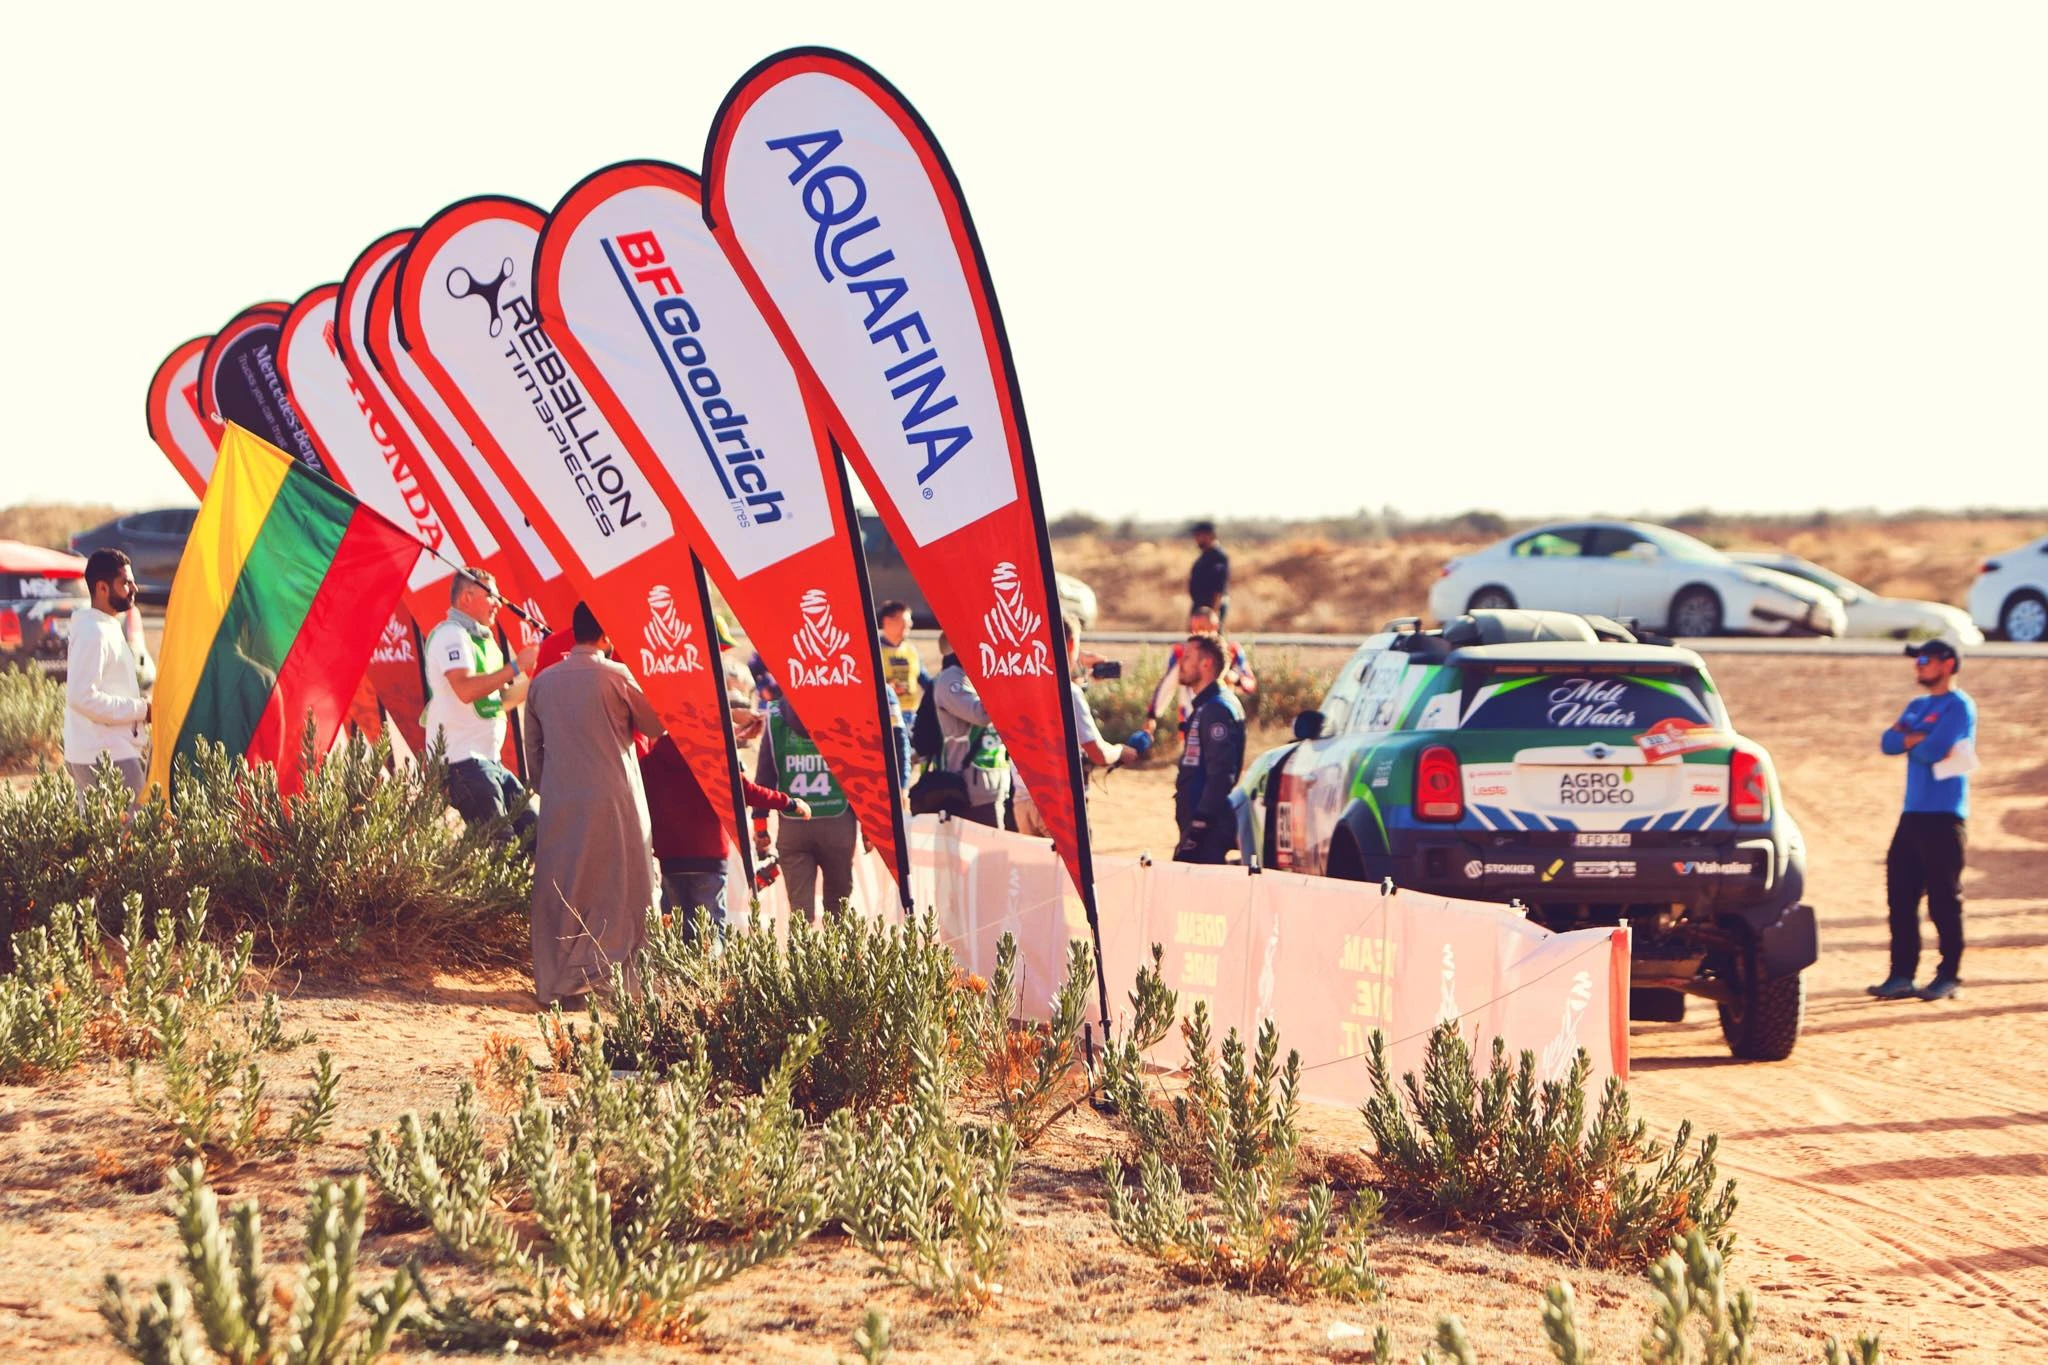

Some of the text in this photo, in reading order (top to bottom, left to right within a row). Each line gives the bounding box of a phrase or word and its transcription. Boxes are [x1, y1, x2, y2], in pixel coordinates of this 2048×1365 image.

[765, 129, 973, 485] AQUAFINA
[615, 229, 785, 525] BFGoodrich
[640, 643, 704, 677] DAKAR
[787, 654, 863, 689] DAKAR
[979, 640, 1054, 679] DAKAR
[1549, 679, 1629, 703] Melt
[1547, 701, 1636, 727] Water
[789, 773, 832, 796] 44
[1560, 773, 1620, 788] AGRO
[1560, 789, 1634, 804] RODEO
[1484, 863, 1535, 875] STOKKER
